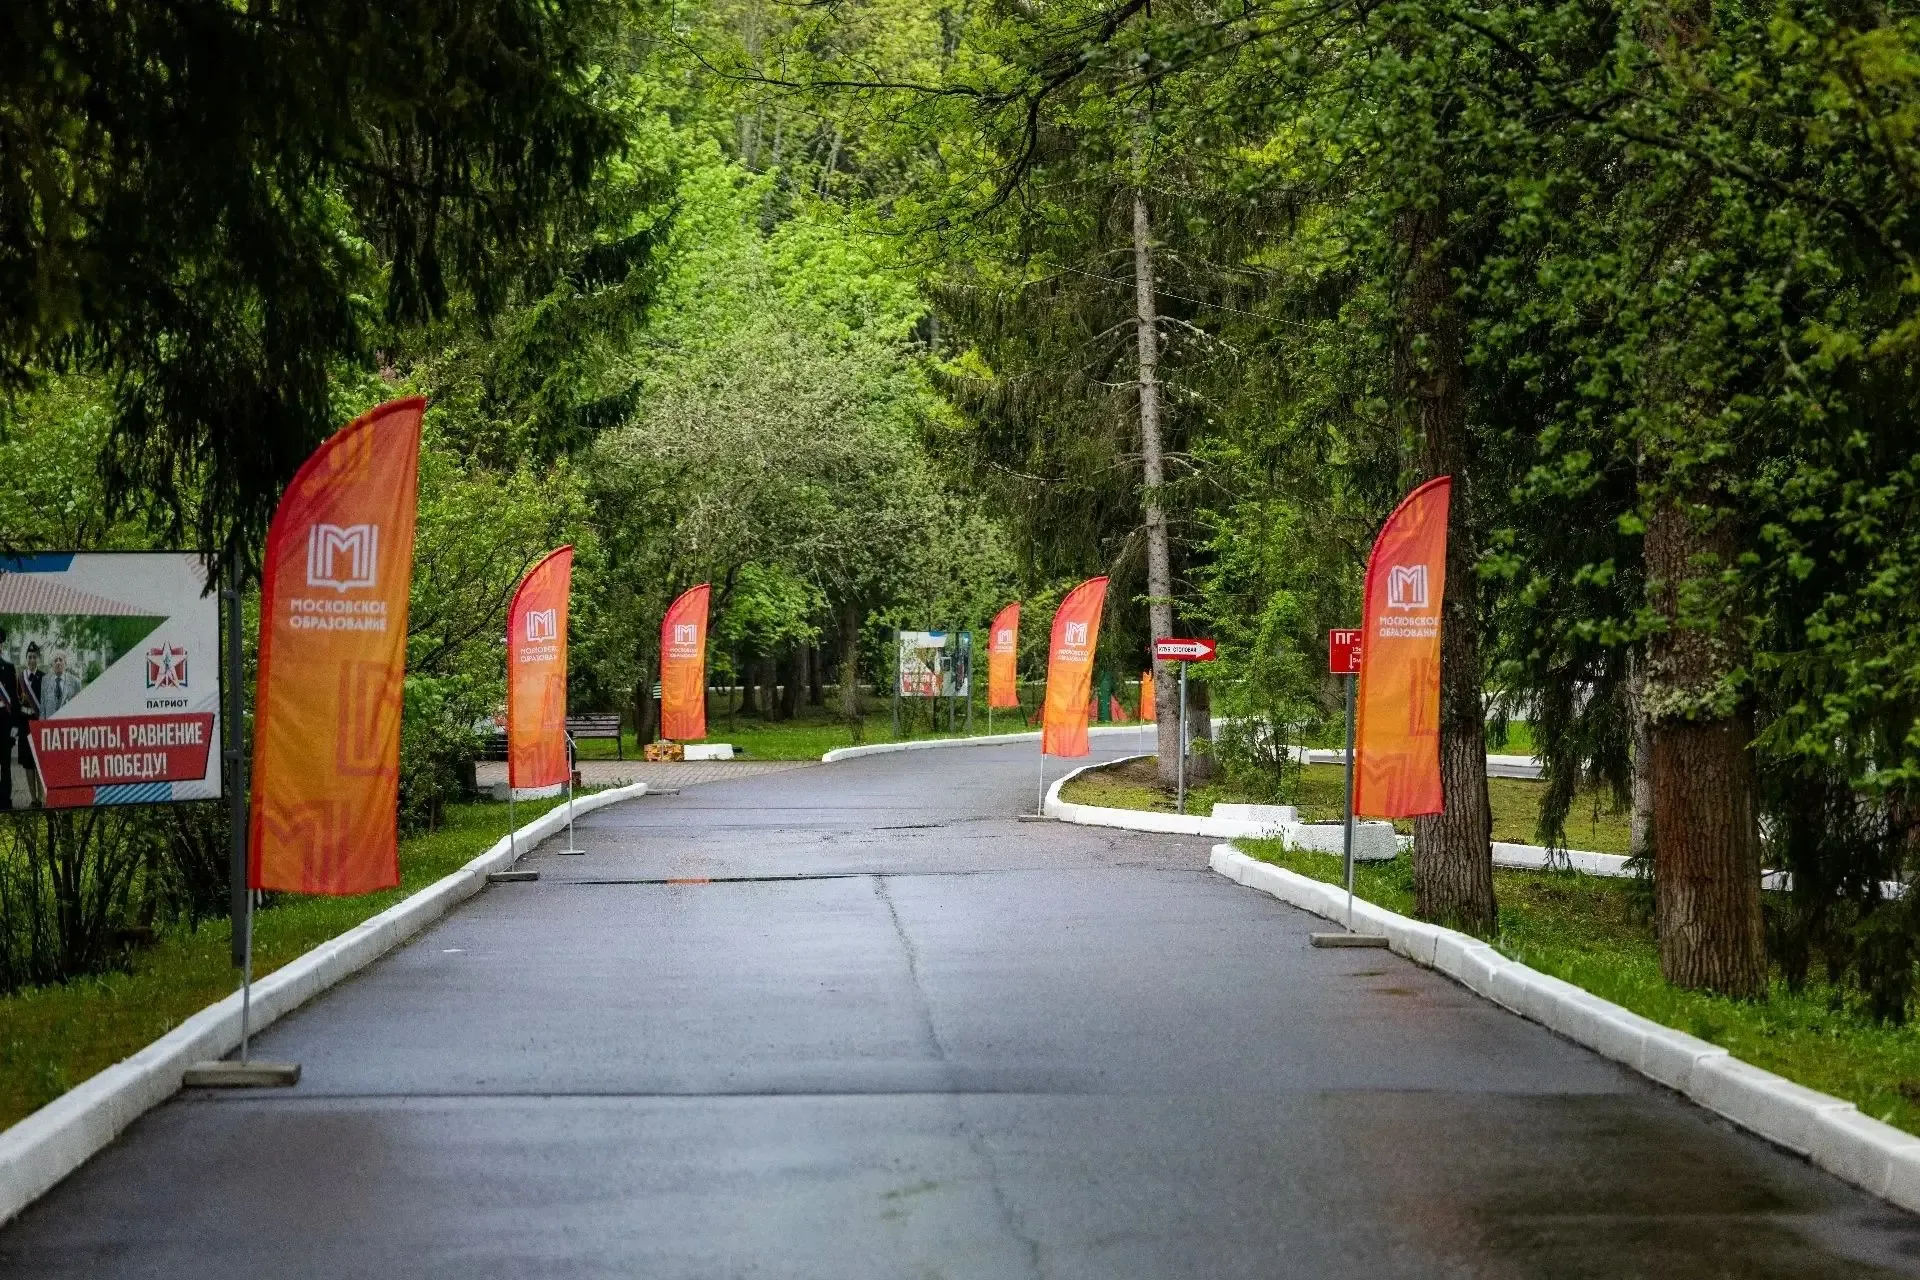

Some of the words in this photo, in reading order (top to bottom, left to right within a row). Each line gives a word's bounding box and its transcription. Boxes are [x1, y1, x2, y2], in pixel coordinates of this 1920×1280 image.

[290, 599, 388, 614] МОСКОВСКОЕ
[289, 615, 387, 631] ОБРАЗОВАНИЕ
[146, 699, 188, 709] ПАТРИОТ
[41, 724, 125, 751] ПАТРИОТЫ,
[128, 722, 203, 747] РАВНЕНИЕ
[80, 755, 101, 779] НА
[104, 752, 167, 779] ПОБЕДУ!
